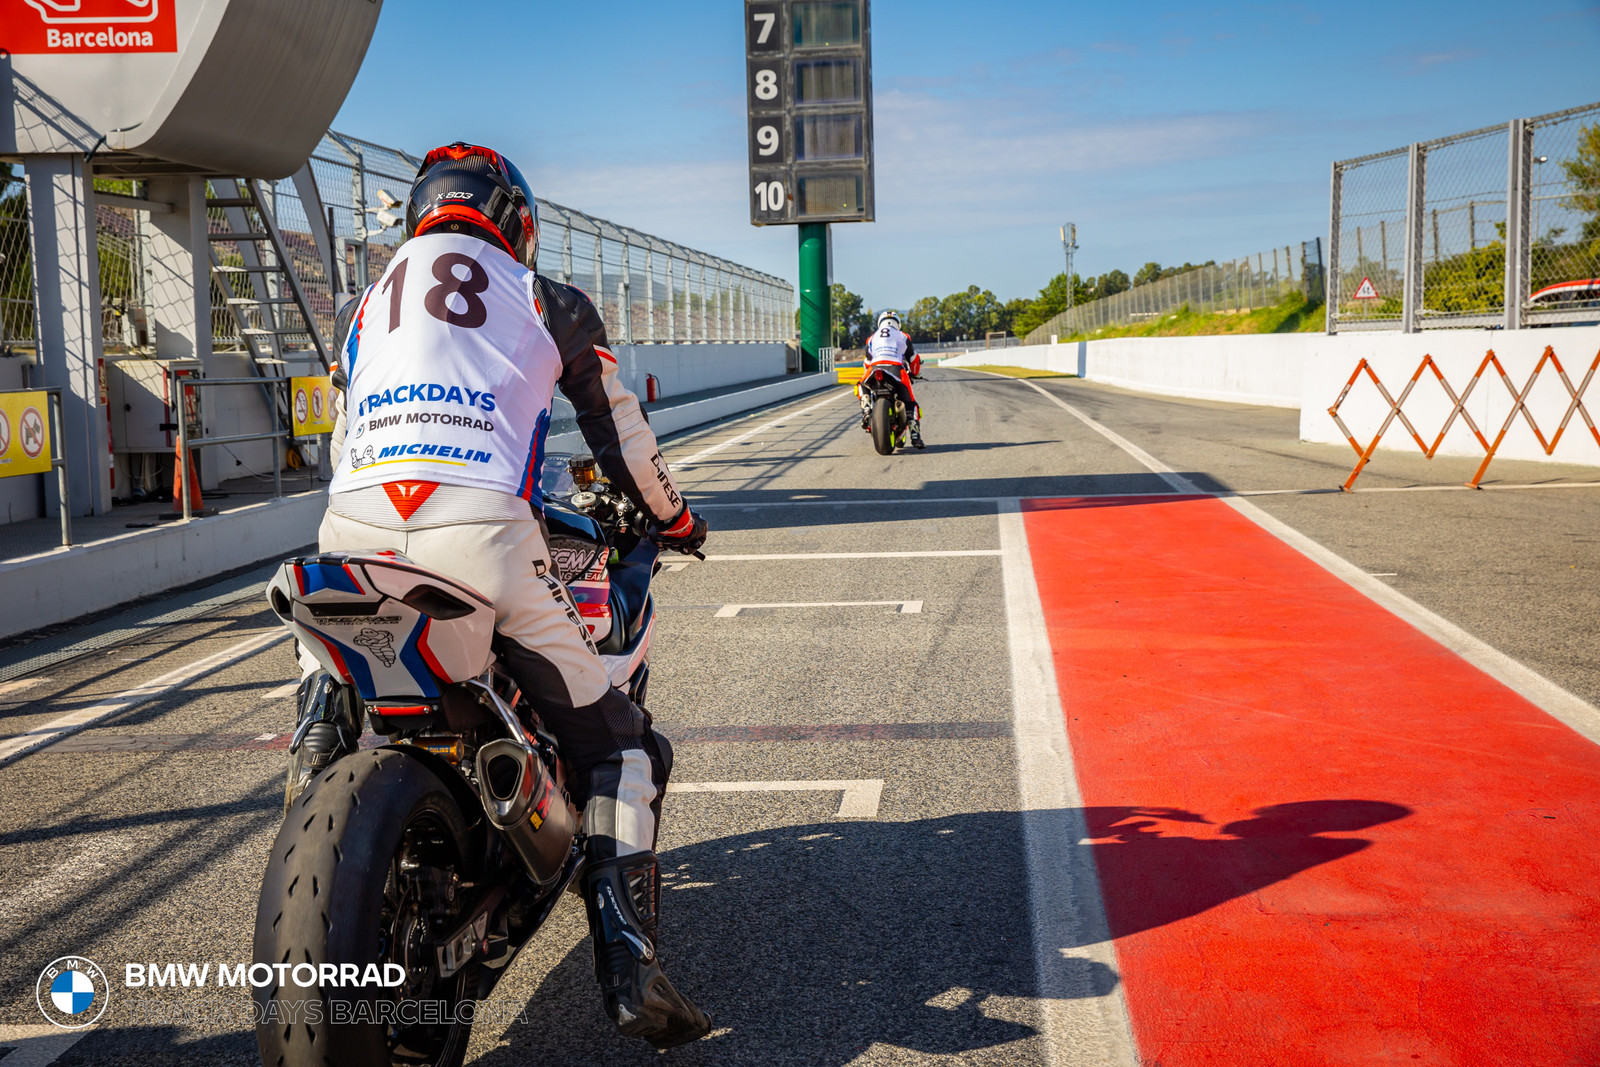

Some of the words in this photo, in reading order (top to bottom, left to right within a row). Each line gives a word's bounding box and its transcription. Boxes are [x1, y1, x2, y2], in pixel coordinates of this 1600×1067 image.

[46, 26, 154, 48] Barcelona
[753, 12, 776, 44] 7
[755, 69, 779, 100] 8
[756, 125, 780, 156] 9
[754, 180, 785, 211] 10
[382, 252, 490, 334] 18
[880, 327, 891, 338] 8
[368, 414, 403, 432] BMW
[405, 412, 495, 432] MOTORRAD
[377, 443, 493, 464] MICHELIN
[531, 558, 598, 656] DAINESE
